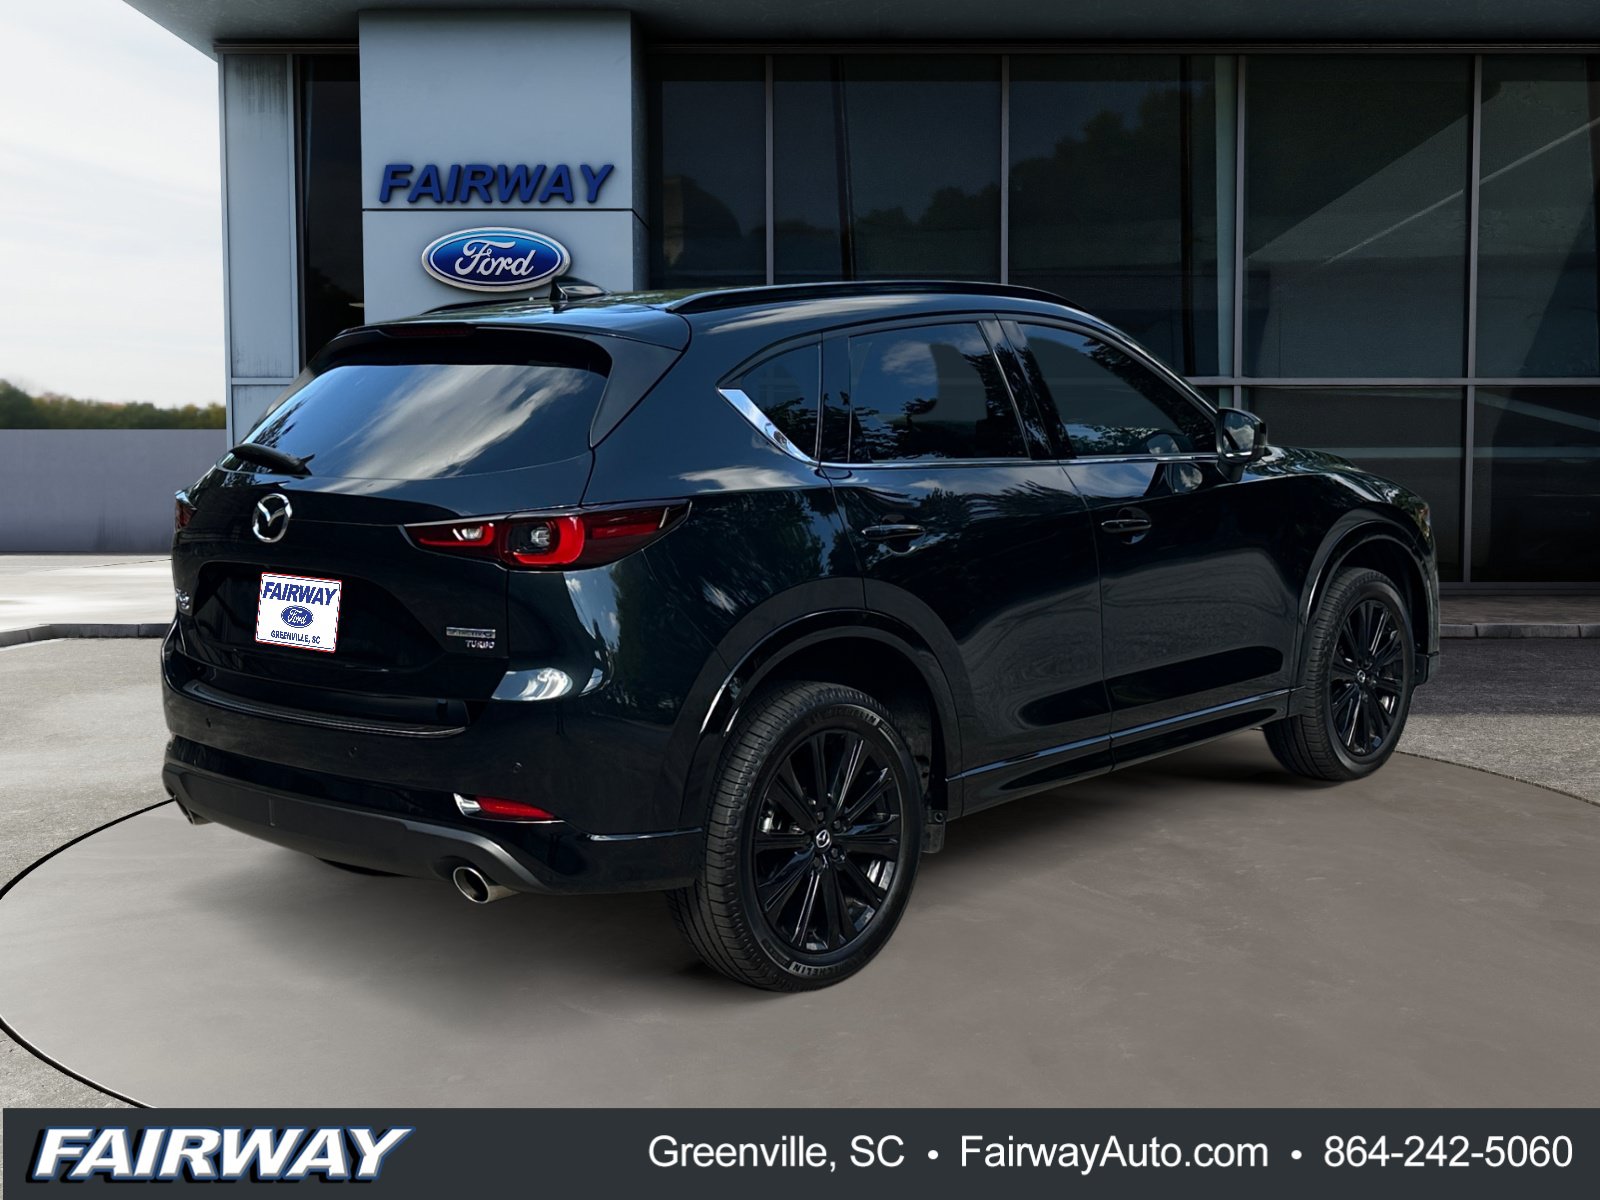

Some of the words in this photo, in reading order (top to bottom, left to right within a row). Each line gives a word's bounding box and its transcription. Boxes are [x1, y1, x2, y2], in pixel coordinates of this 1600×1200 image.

[379, 164, 615, 204] FAIRWAY
[454, 239, 536, 276] Ford
[262, 581, 338, 606] FAIRWAY
[287, 608, 308, 625] Ford
[270, 630, 311, 644] GREENVILLE,
[311, 635, 321, 645] SC
[464, 638, 496, 649] TURBO
